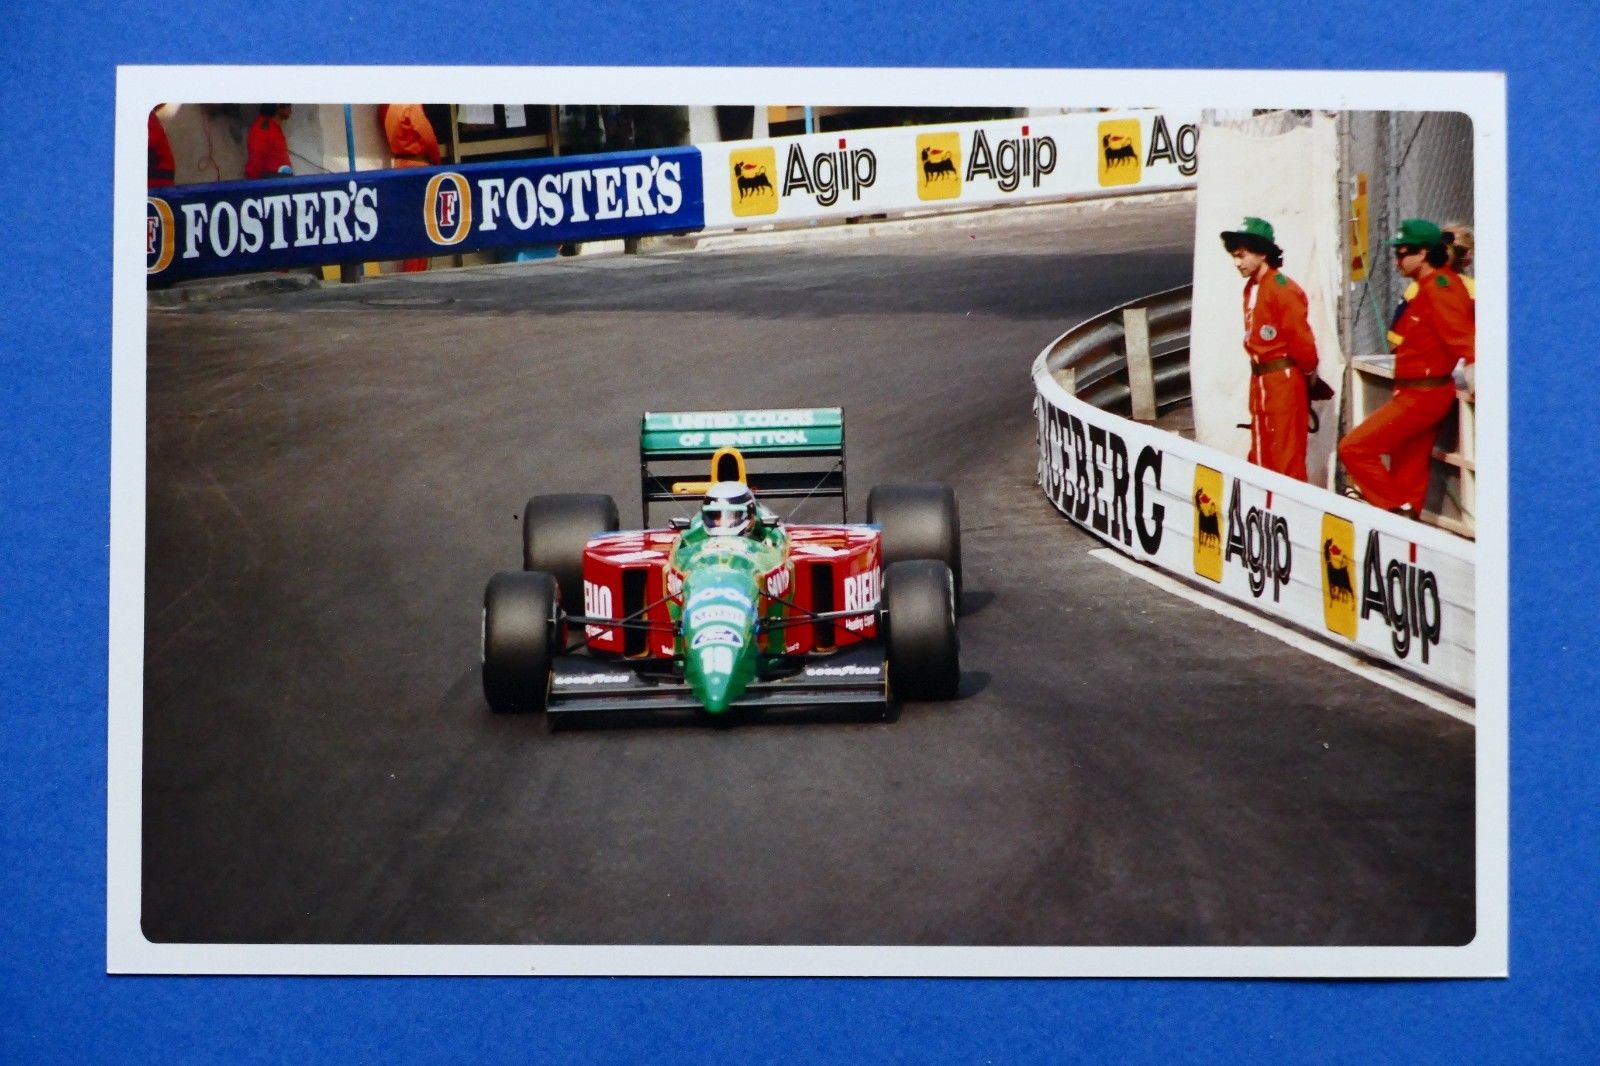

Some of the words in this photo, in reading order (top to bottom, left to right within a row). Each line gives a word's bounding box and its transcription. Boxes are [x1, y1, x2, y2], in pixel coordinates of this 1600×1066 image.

[478, 155, 683, 232] FOSTER'S
[782, 138, 877, 207] Agip
[966, 125, 1057, 193] Agip
[181, 180, 379, 259] FOSTER'S
[672, 413, 738, 429] UNITED
[743, 410, 815, 426] COLORS
[679, 432, 705, 447] OF
[1225, 477, 1292, 603] Agip
[1361, 528, 1441, 665] Agip
